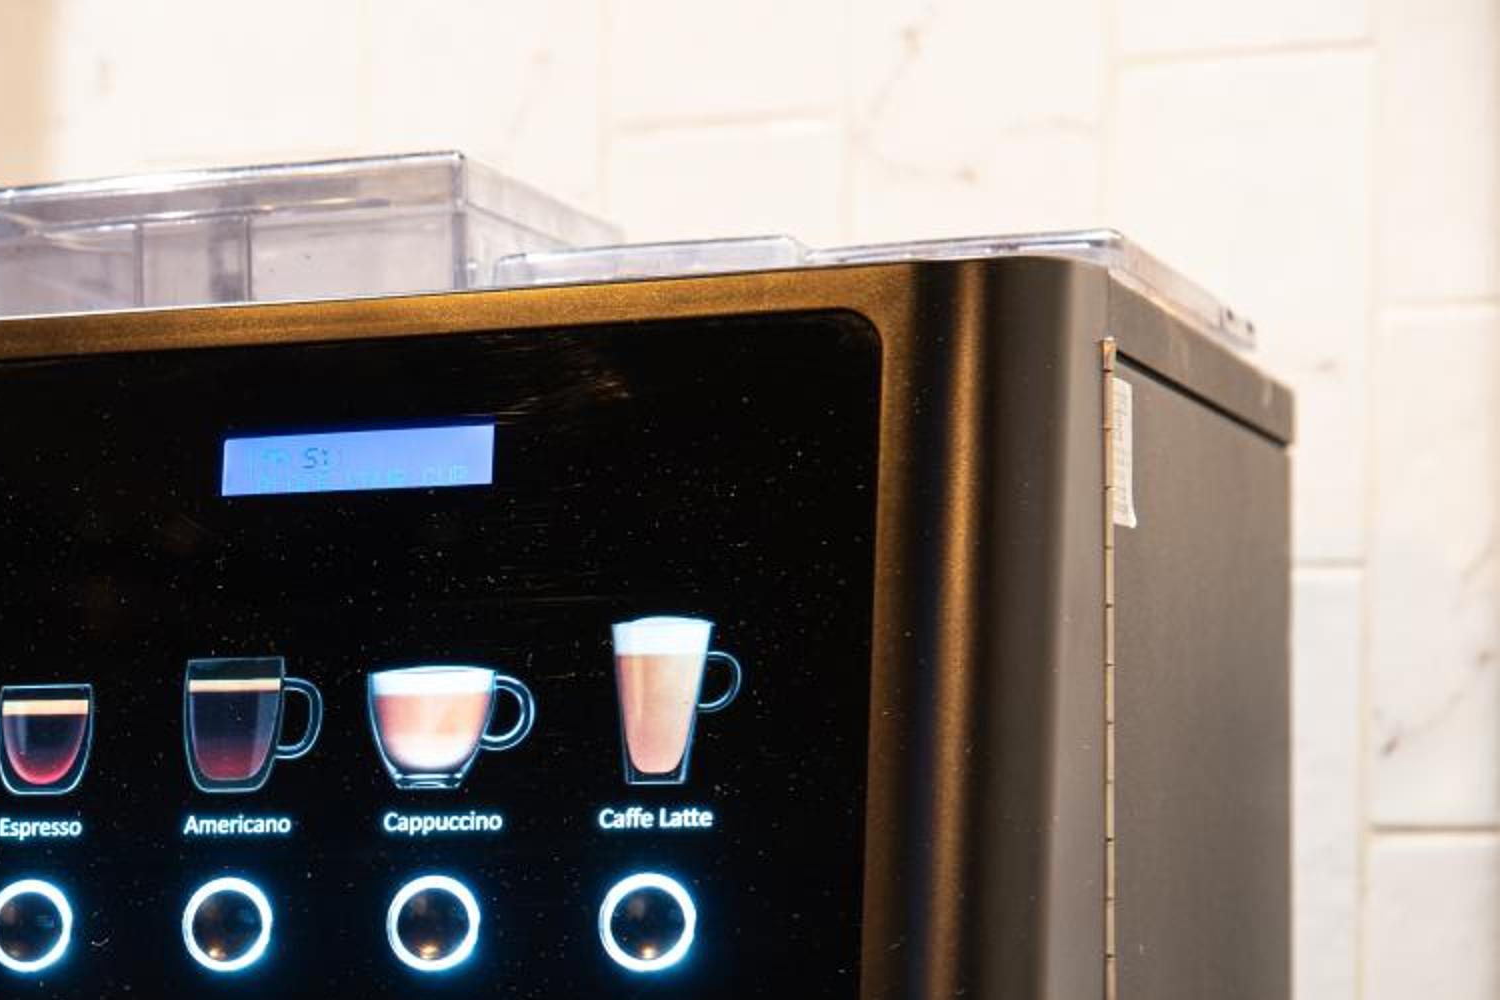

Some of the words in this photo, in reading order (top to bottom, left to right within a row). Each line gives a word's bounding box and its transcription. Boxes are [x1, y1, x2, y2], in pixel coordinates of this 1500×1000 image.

[0, 817, 82, 841] Espresso
[183, 814, 291, 835] Americano
[383, 810, 503, 836] Cappuccino
[598, 806, 655, 829] Caffe
[659, 808, 713, 828] Latte
